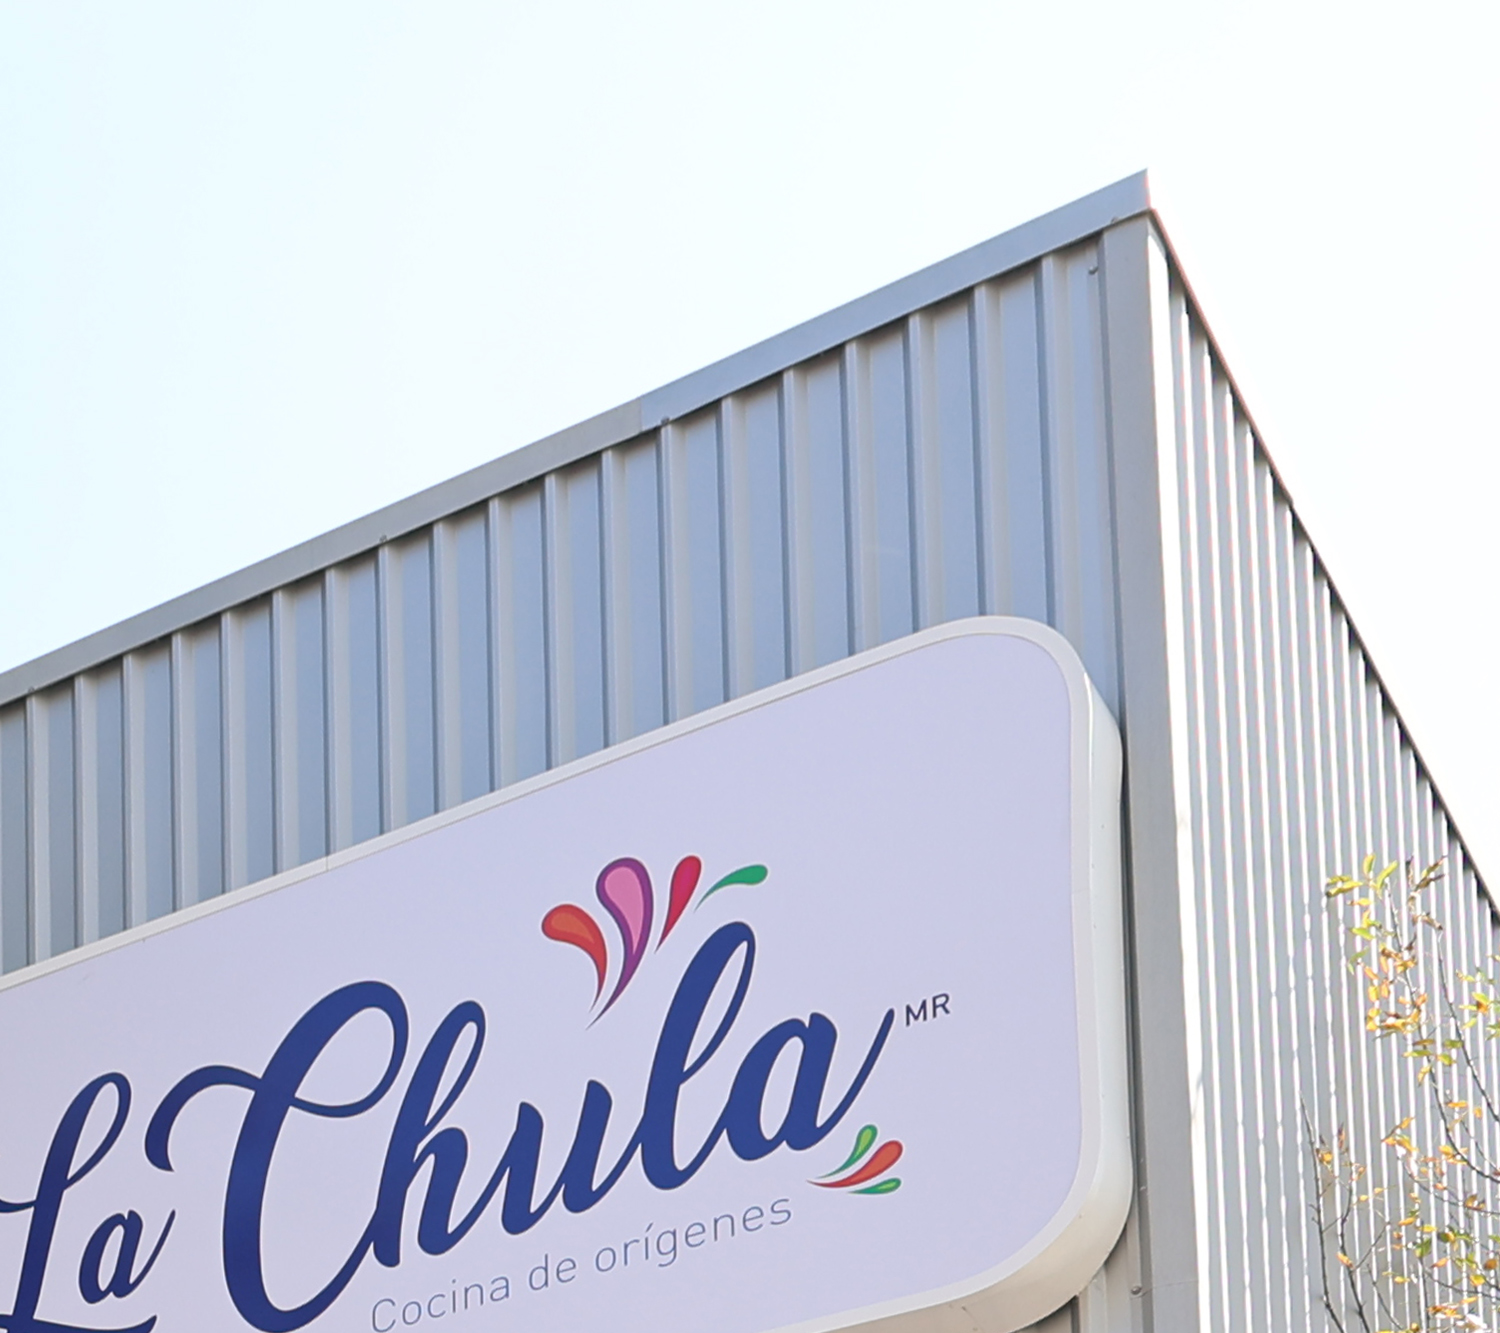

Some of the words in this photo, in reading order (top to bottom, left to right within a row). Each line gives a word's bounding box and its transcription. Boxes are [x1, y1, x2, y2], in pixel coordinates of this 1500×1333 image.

[144, 921, 896, 1333] Chula
[905, 992, 950, 1027] MR
[370, 1275, 511, 1333] Cocina
[528, 1253, 577, 1291] de
[594, 1198, 792, 1272] orígenes
